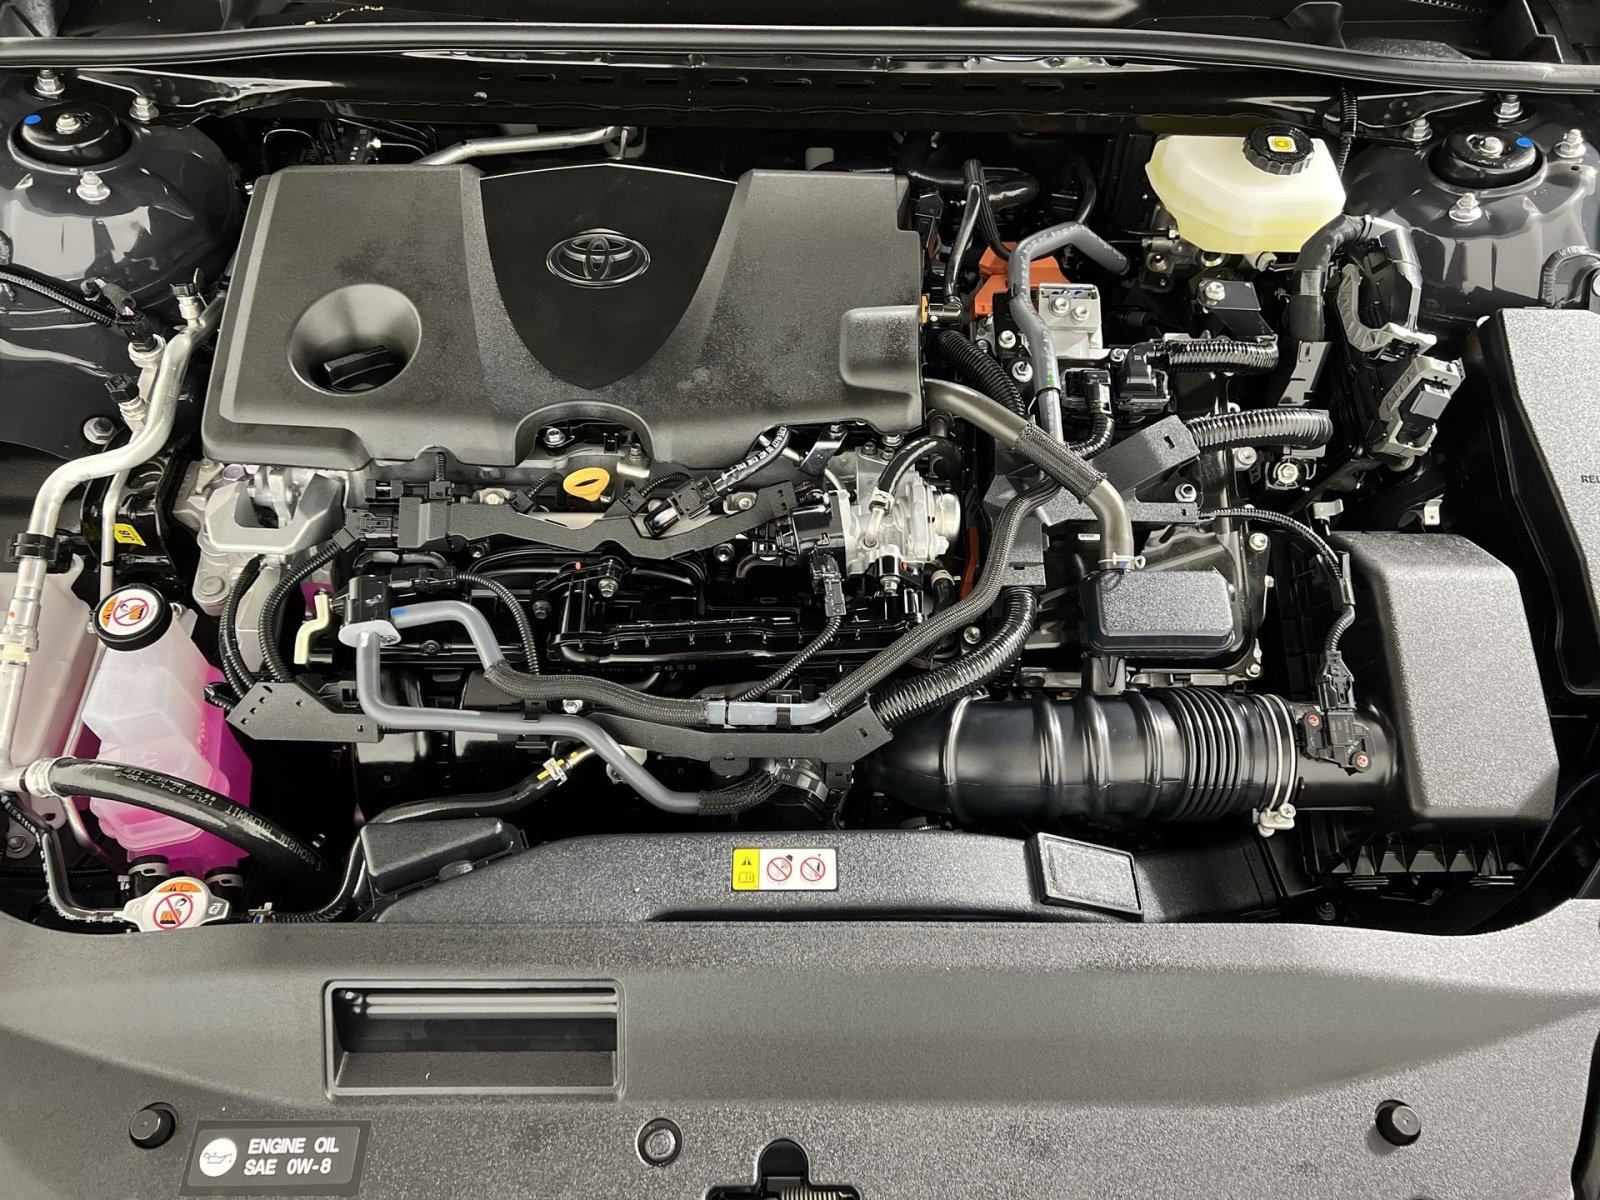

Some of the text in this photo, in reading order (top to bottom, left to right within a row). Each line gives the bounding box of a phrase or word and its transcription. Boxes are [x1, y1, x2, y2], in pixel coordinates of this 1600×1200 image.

[248, 1137, 339, 1154] ENGINE OIL
[244, 1158, 332, 1175] SAE 0W-8
